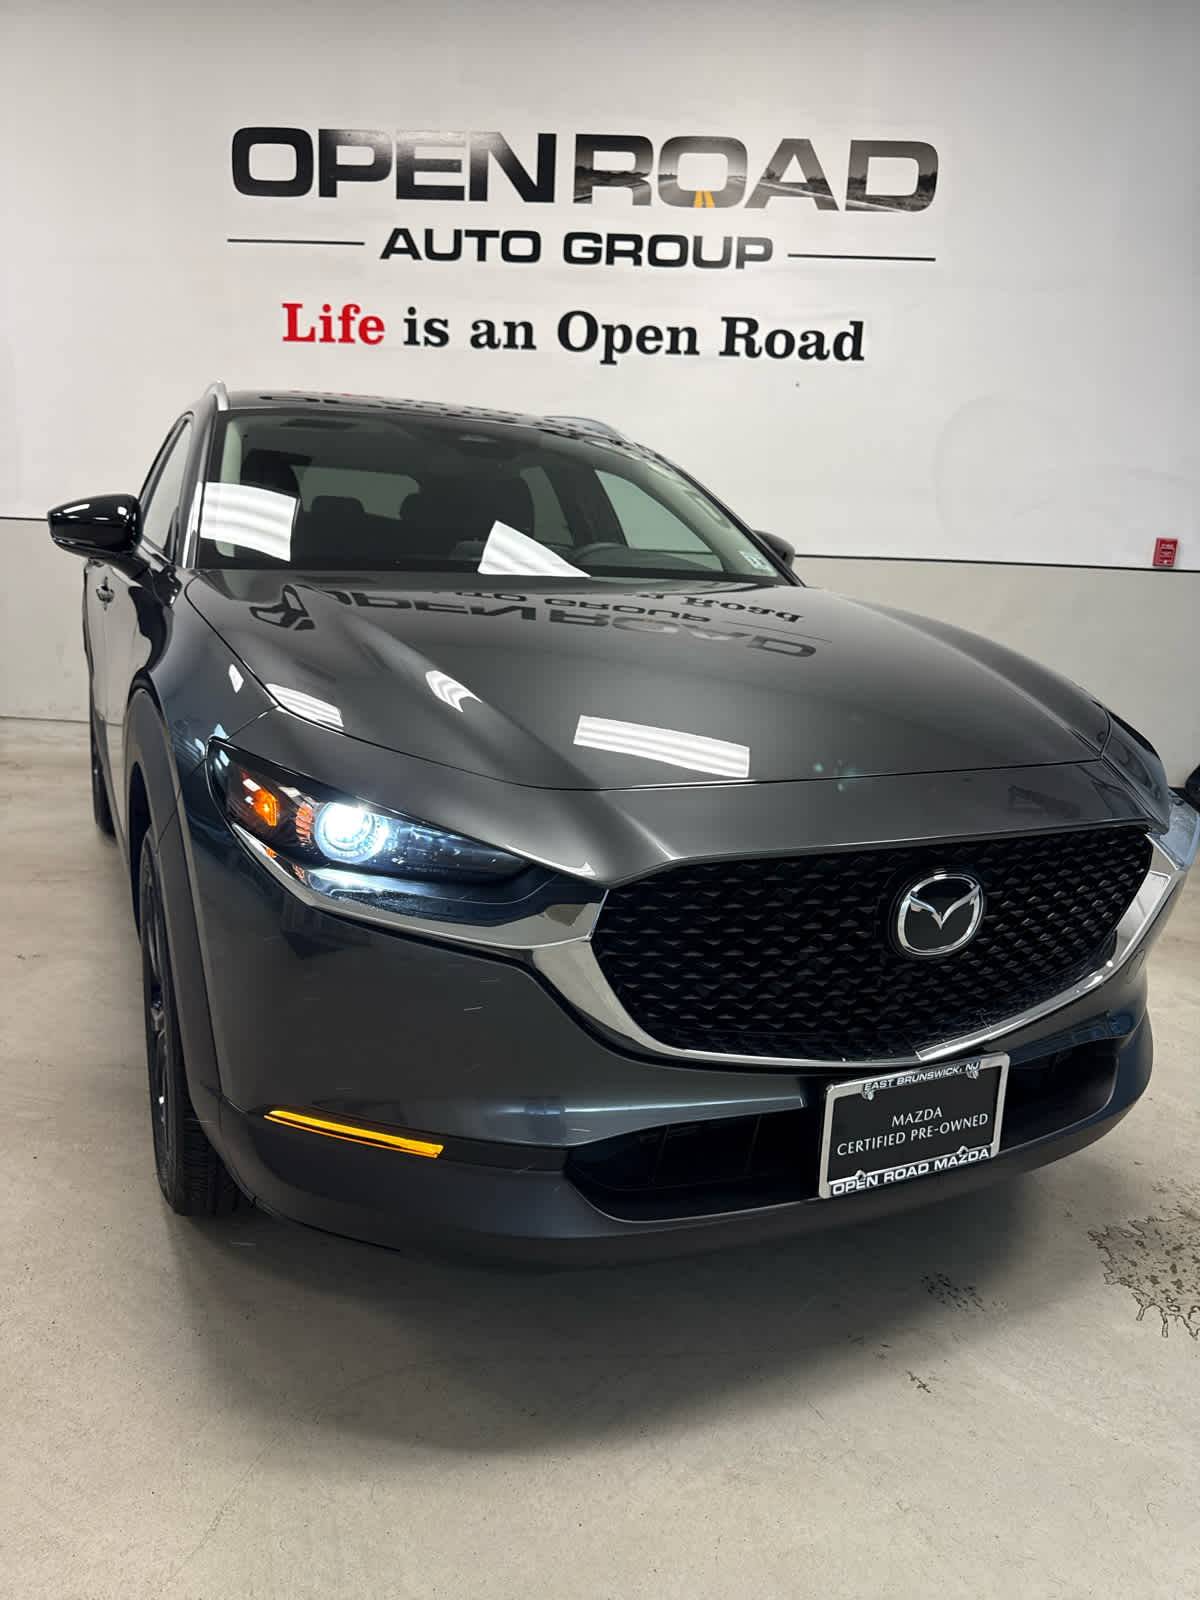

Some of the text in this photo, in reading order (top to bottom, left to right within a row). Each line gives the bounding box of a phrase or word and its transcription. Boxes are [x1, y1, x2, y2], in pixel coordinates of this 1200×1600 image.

[231, 126, 939, 213] OPEN ROAD
[380, 227, 773, 269] AUTO GROUP
[282, 302, 865, 365] Life is an Open Road
[864, 1078, 895, 1091] EAST
[965, 1061, 980, 1071] NJ
[837, 1113, 989, 1156] CERTIFIED PRE-OWNED
[891, 1107, 943, 1128] MAZDA
[832, 1148, 990, 1195] OPEN ROAD MAZDA
